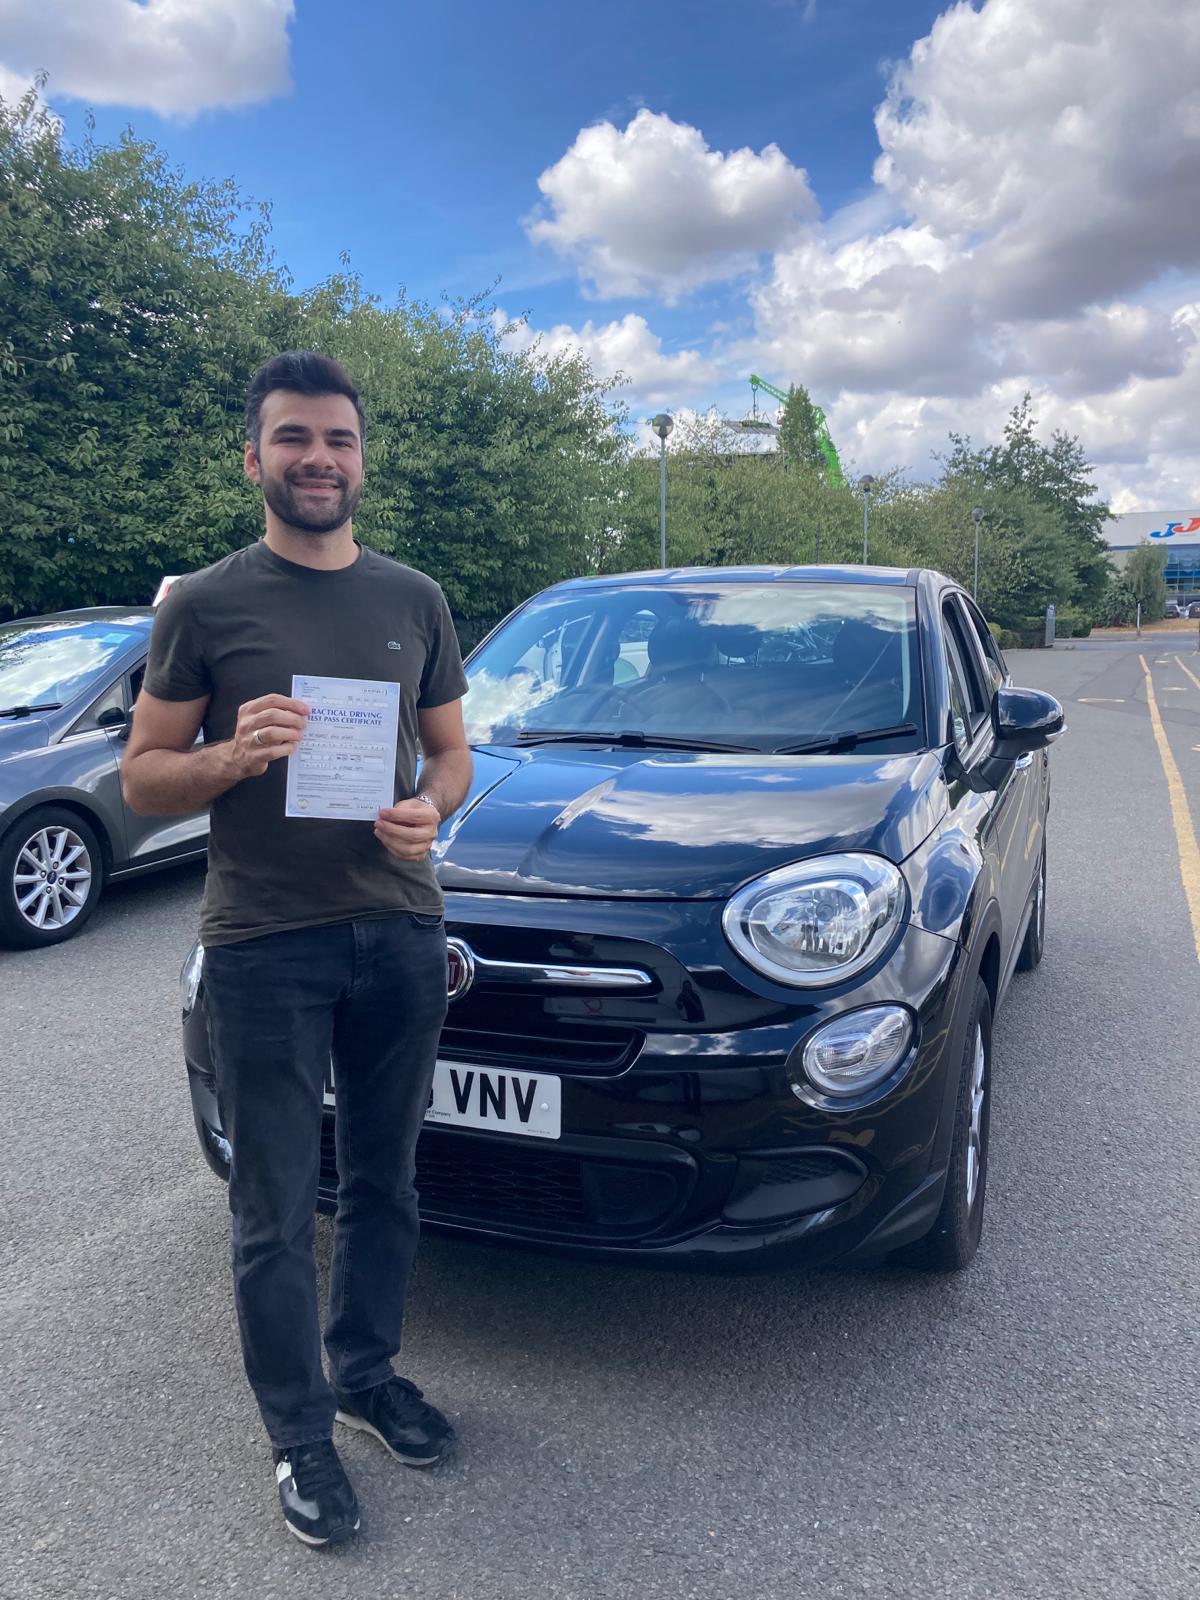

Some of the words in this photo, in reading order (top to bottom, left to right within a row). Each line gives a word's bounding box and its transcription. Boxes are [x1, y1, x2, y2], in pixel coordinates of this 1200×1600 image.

[311, 707, 347, 717] RACTICAL
[349, 710, 383, 719] DRIVING
[341, 717, 382, 726] CERTIFICATE
[450, 1069, 538, 1123] VNV
